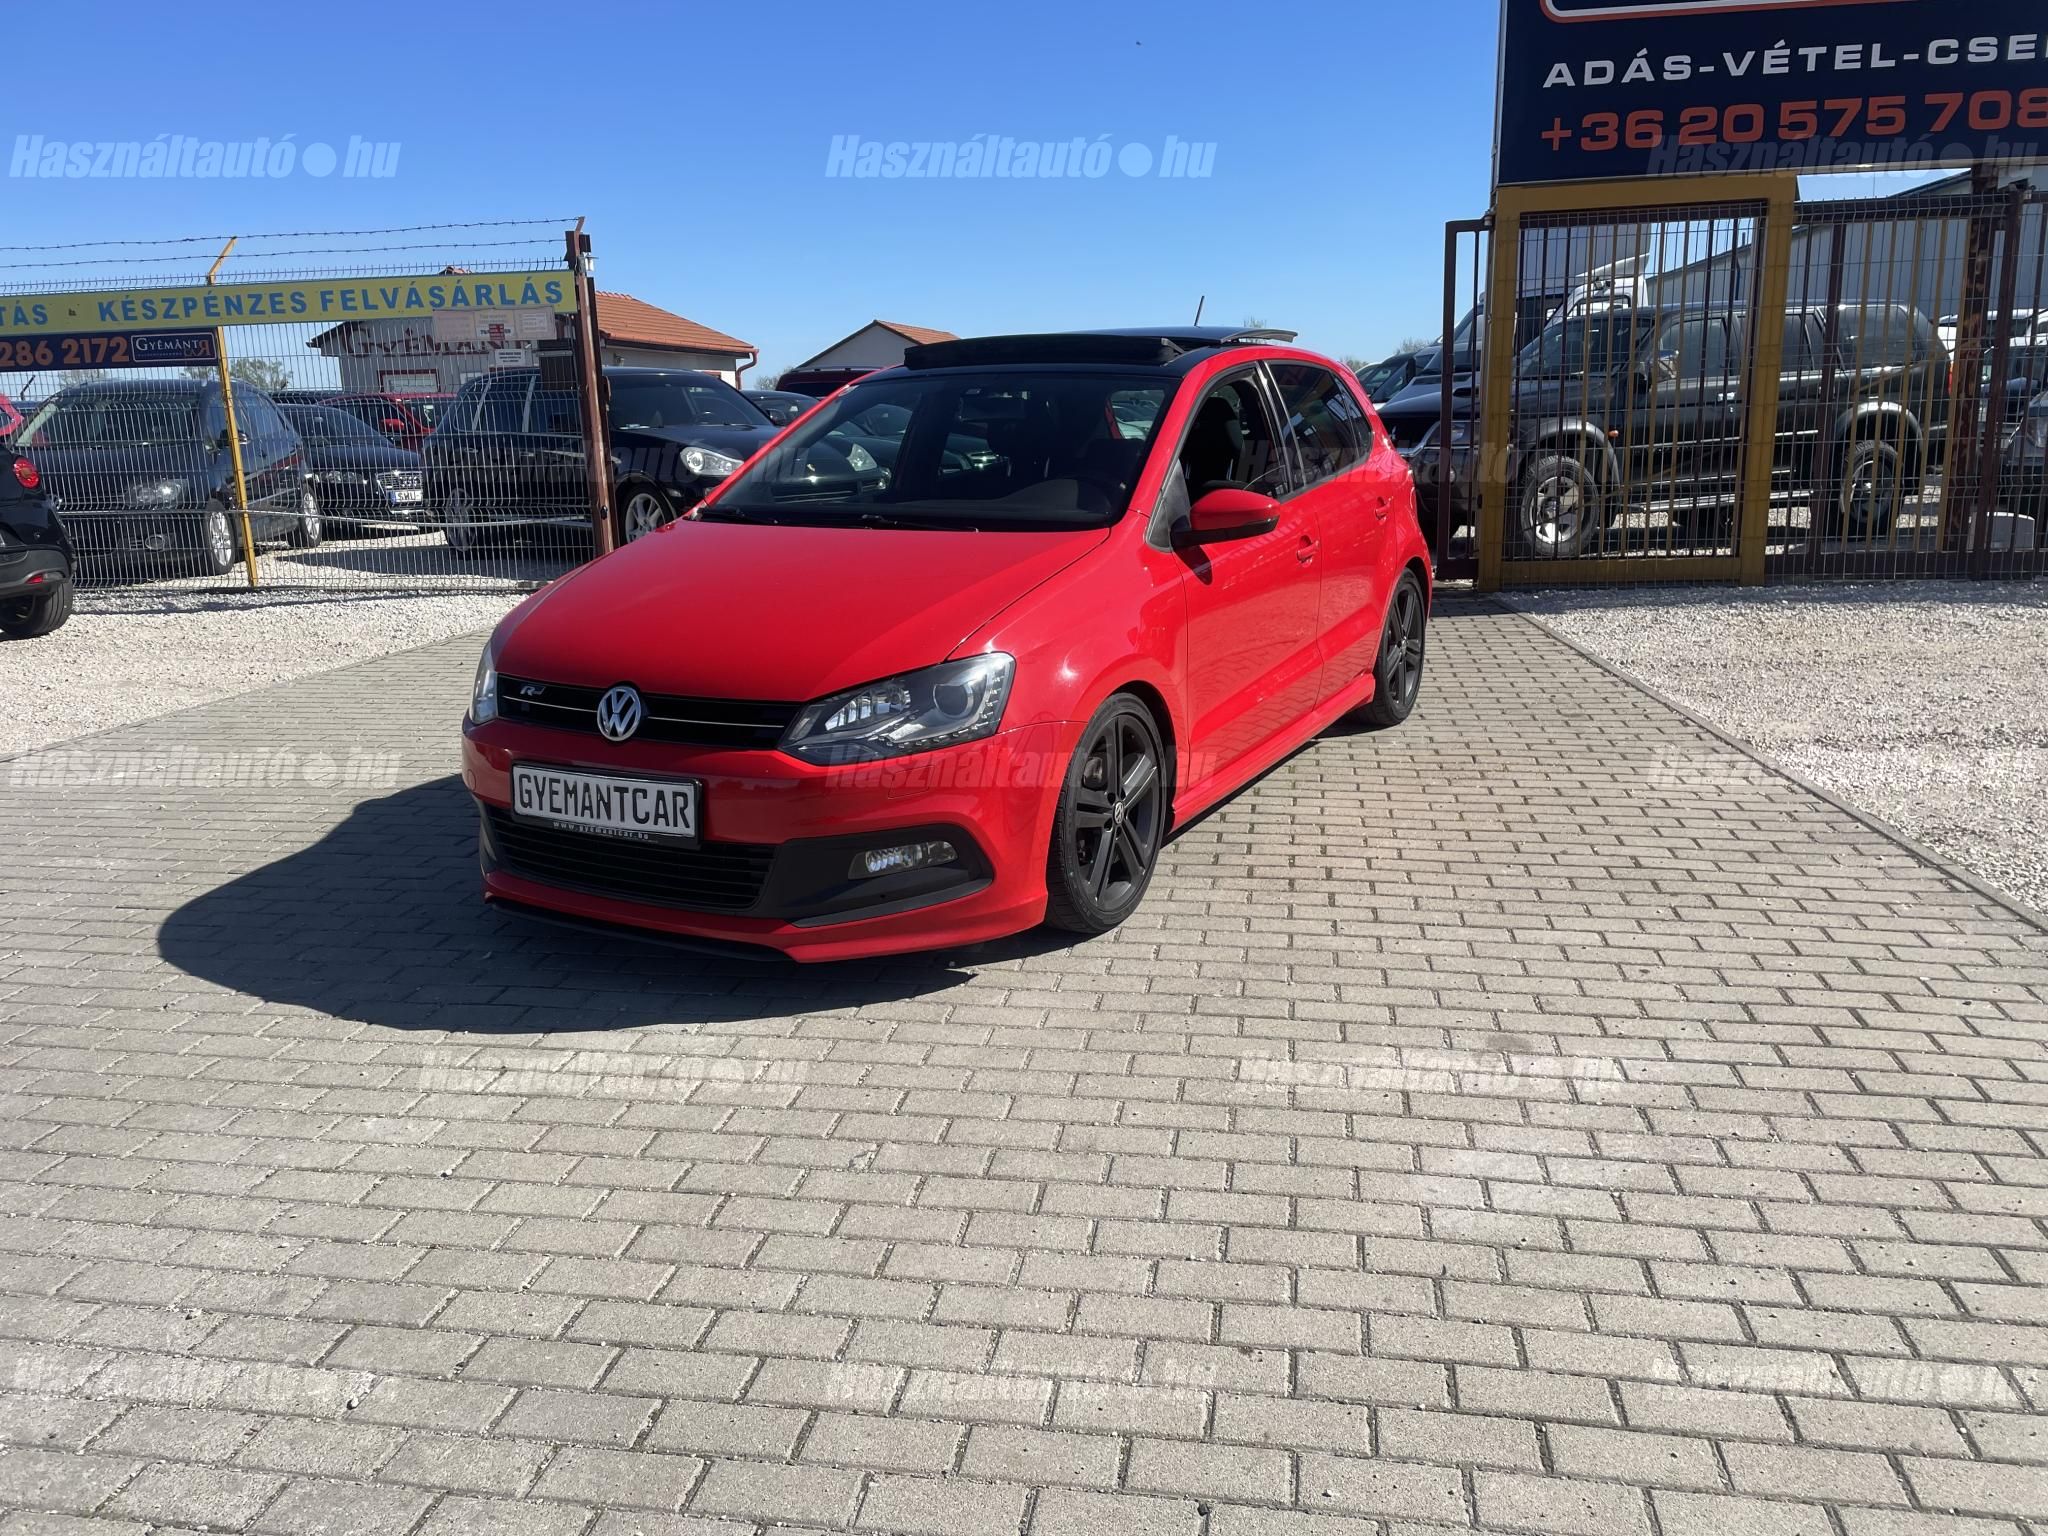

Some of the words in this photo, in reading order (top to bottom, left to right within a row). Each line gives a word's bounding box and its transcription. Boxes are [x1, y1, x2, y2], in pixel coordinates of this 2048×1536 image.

[1542, 34, 2048, 88] ADÁS-VÉTEL-CSE
[1541, 109, 1664, 151] +36
[1678, 103, 1765, 146] 20
[1777, 95, 1906, 140] 575
[97, 290, 306, 322] KÉSZPÉNZES
[319, 276, 563, 313] FELVÁSÁRLÁS
[0, 339, 54, 367] 286
[61, 335, 130, 366] 2172
[518, 773, 690, 829] GYEMANTCAR
